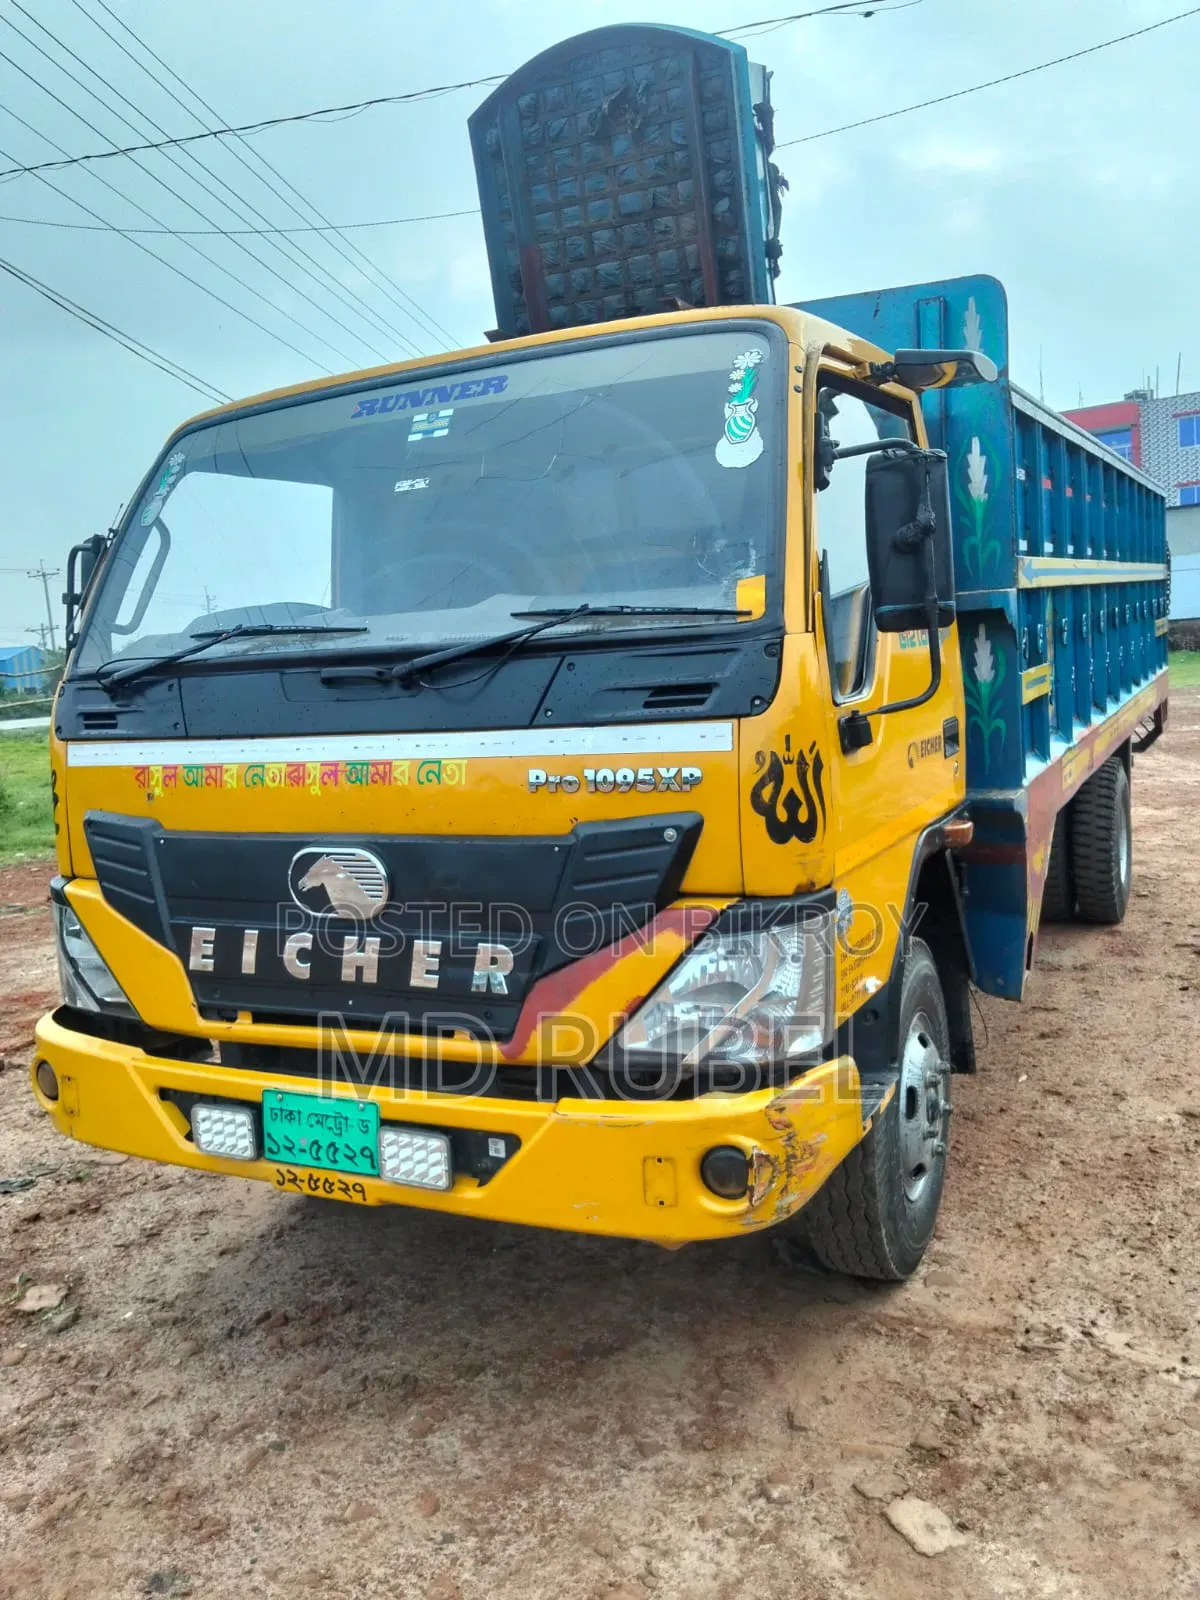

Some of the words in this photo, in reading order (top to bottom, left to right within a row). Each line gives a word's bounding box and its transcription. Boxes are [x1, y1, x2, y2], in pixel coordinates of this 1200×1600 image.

[351, 375, 509, 419] RUNNER
[920, 735, 943, 759] EICHER
[182, 763, 239, 789] আমার
[345, 760, 411, 788] আমার
[417, 759, 468, 787] নেতা
[528, 769, 580, 793] Pro
[583, 767, 704, 794] 1095XP
[189, 927, 515, 995] EICHER
[270, 1107, 302, 1125] ঢাকা
[266, 1132, 377, 1170] ১২-৫৫২৭
[275, 1168, 368, 1202] ১২-৫৫২৭
